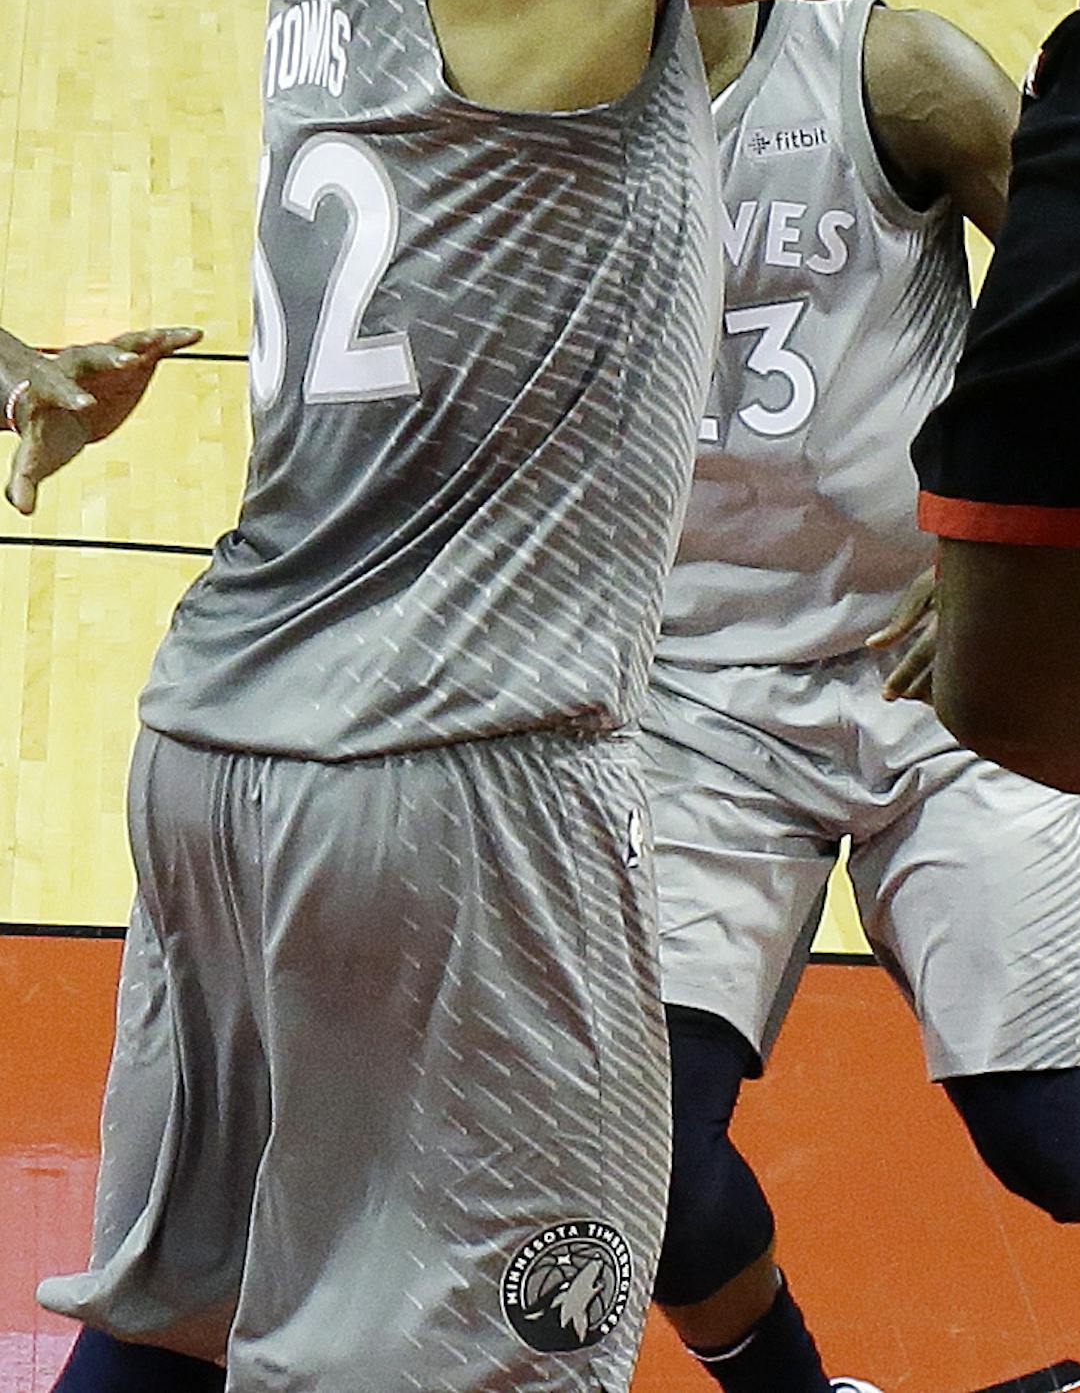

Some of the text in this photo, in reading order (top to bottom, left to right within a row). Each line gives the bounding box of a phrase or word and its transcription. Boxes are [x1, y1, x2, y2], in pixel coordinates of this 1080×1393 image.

[775, 127, 828, 151] fitbit
[698, 300, 818, 437] 3
[505, 1225, 579, 1306] MINNESOTA
